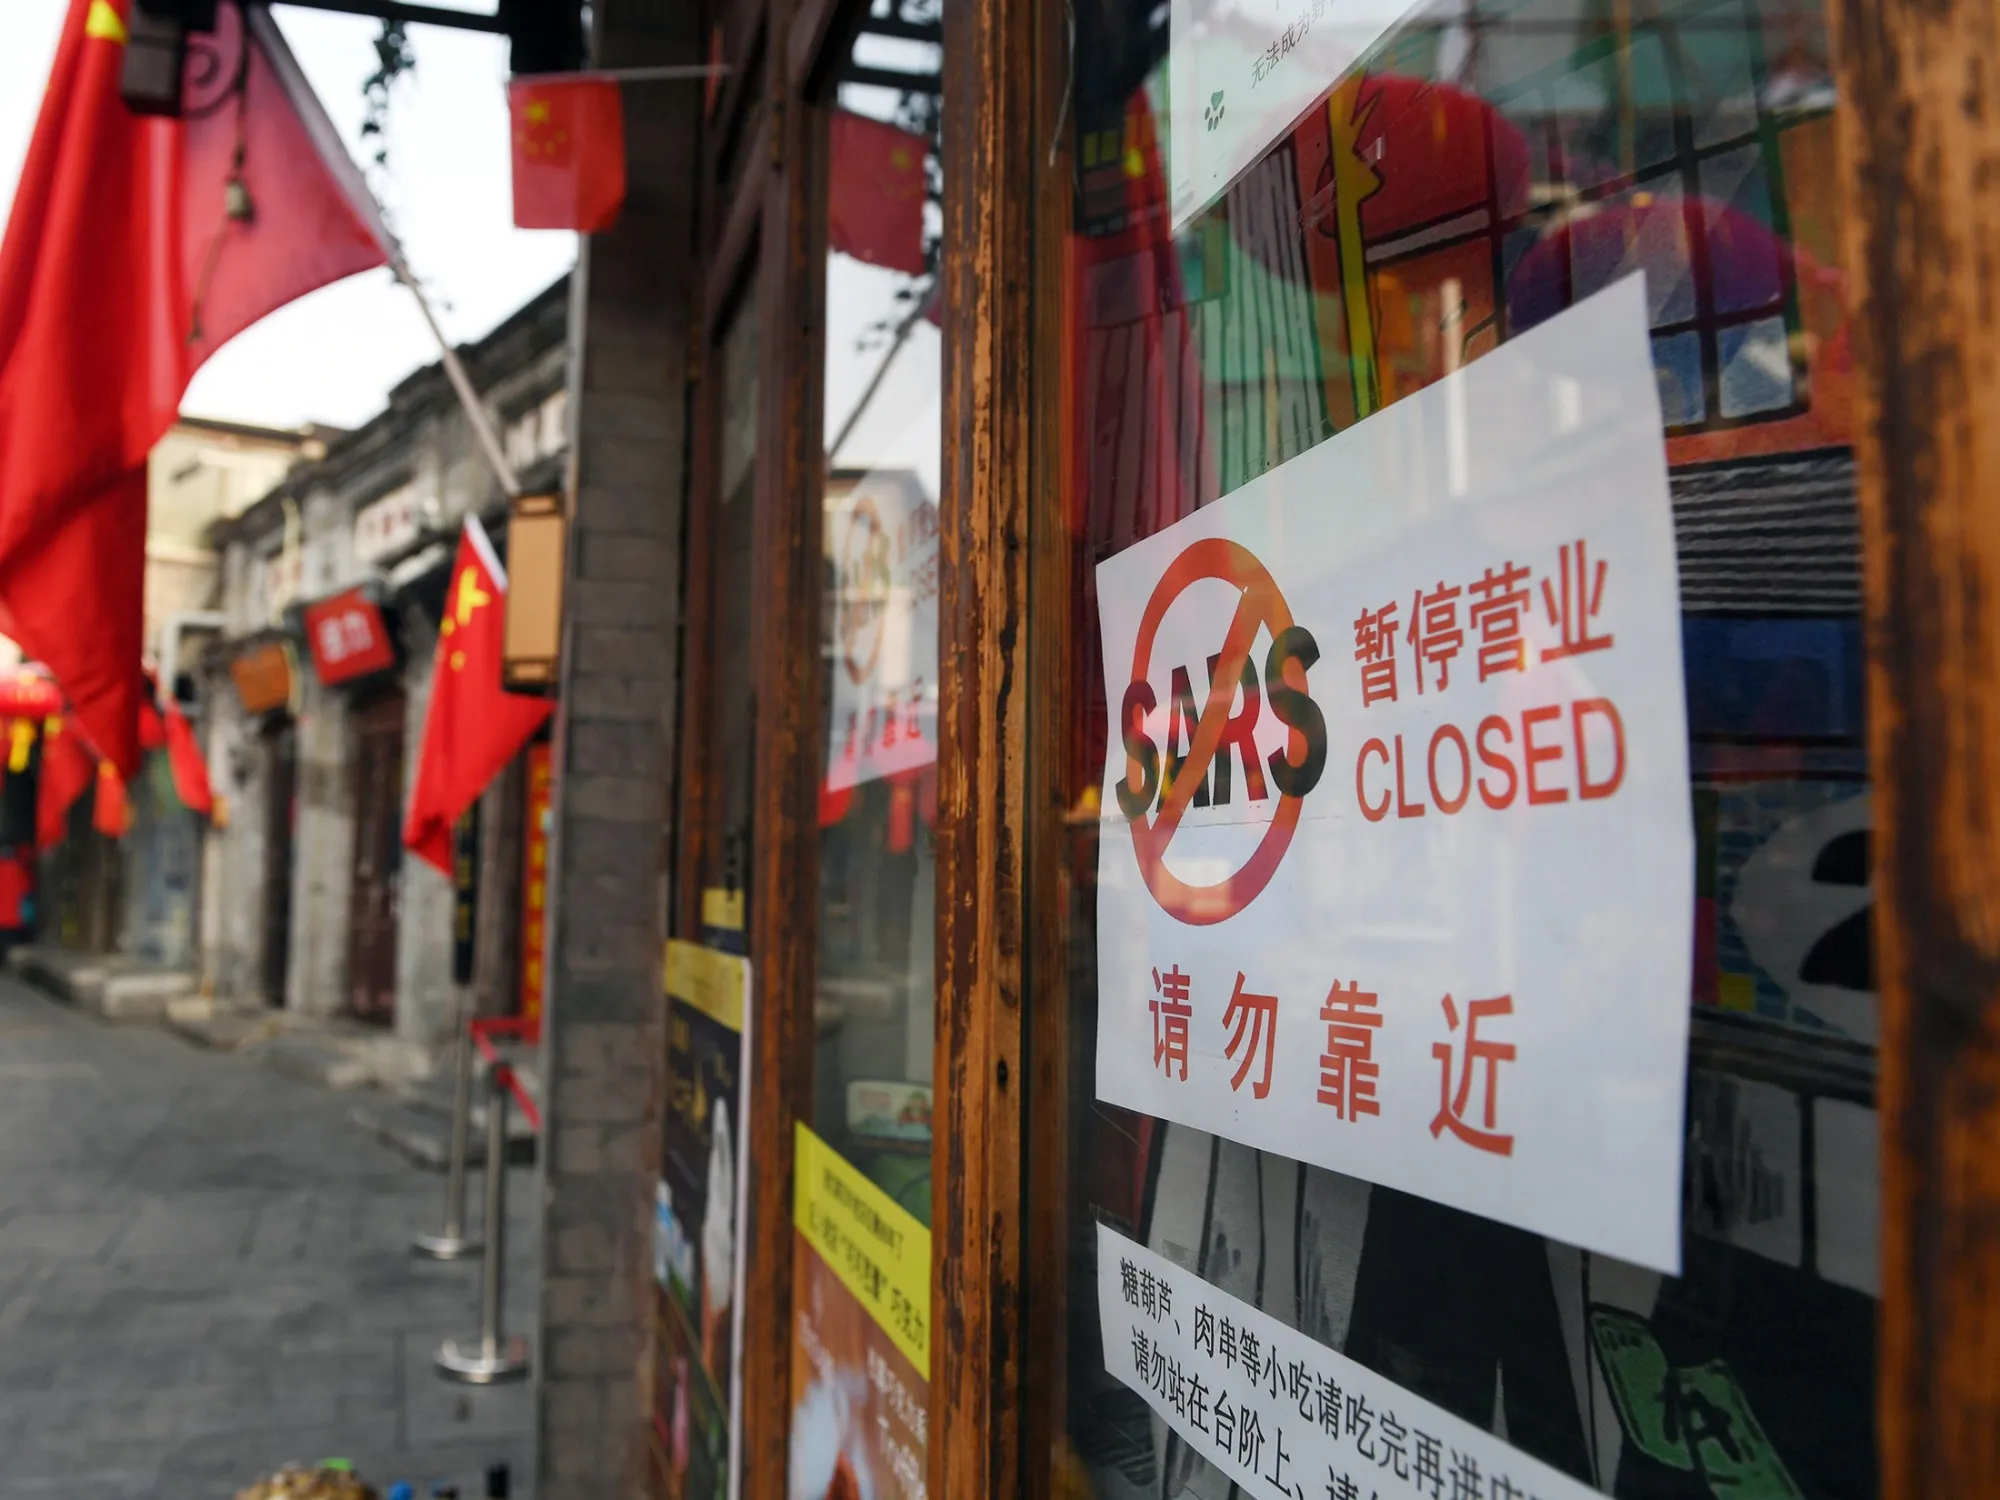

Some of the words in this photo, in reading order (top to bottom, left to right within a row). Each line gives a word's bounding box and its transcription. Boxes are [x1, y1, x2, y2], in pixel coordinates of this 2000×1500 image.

[1353, 539, 1614, 708] 暂停营业
[1115, 625, 1328, 820] SARS
[1356, 697, 1627, 822] CLOSED
[1148, 964, 1517, 1158] 请勿靠近
[1119, 1256, 1541, 1500] 糖葫芦、肉串等小吃请吃完再进
